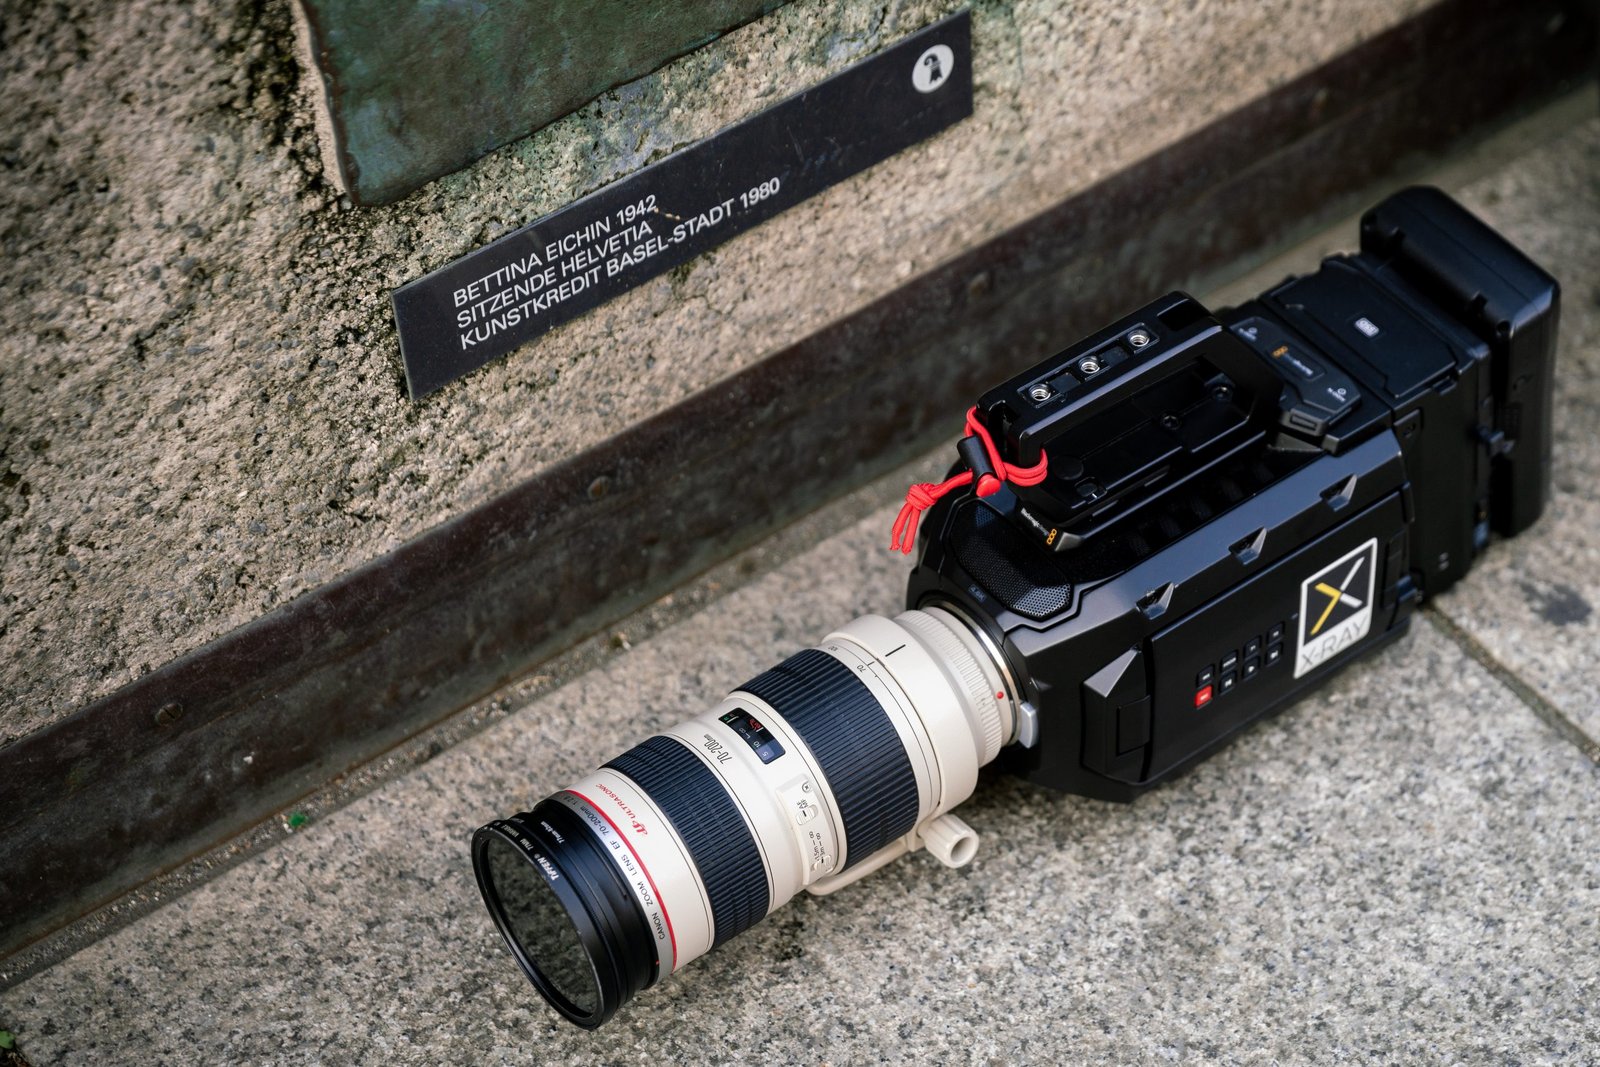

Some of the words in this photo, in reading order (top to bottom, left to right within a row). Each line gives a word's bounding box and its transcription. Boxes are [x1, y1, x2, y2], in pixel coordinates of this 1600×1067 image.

[453, 253, 542, 308] BETTINA
[546, 218, 611, 262] EICHIN
[616, 194, 657, 226] 1942
[460, 265, 602, 351] KUNSTKREDIT
[606, 198, 735, 278] BASEL-STADT
[739, 177, 781, 209] 1980
[456, 266, 556, 329] SITZENDE
[561, 220, 653, 278] HELVETIA
[1301, 612, 1369, 674] X-RAY
[703, 733, 733, 765] 70-200mm
[595, 783, 636, 820] ULTRASONIC
[580, 805, 610, 836] 70-200mm
[609, 840, 621, 850] EF
[621, 854, 638, 876] LENS
[636, 881, 654, 907] ZOOM
[651, 912, 666, 940] CANON
